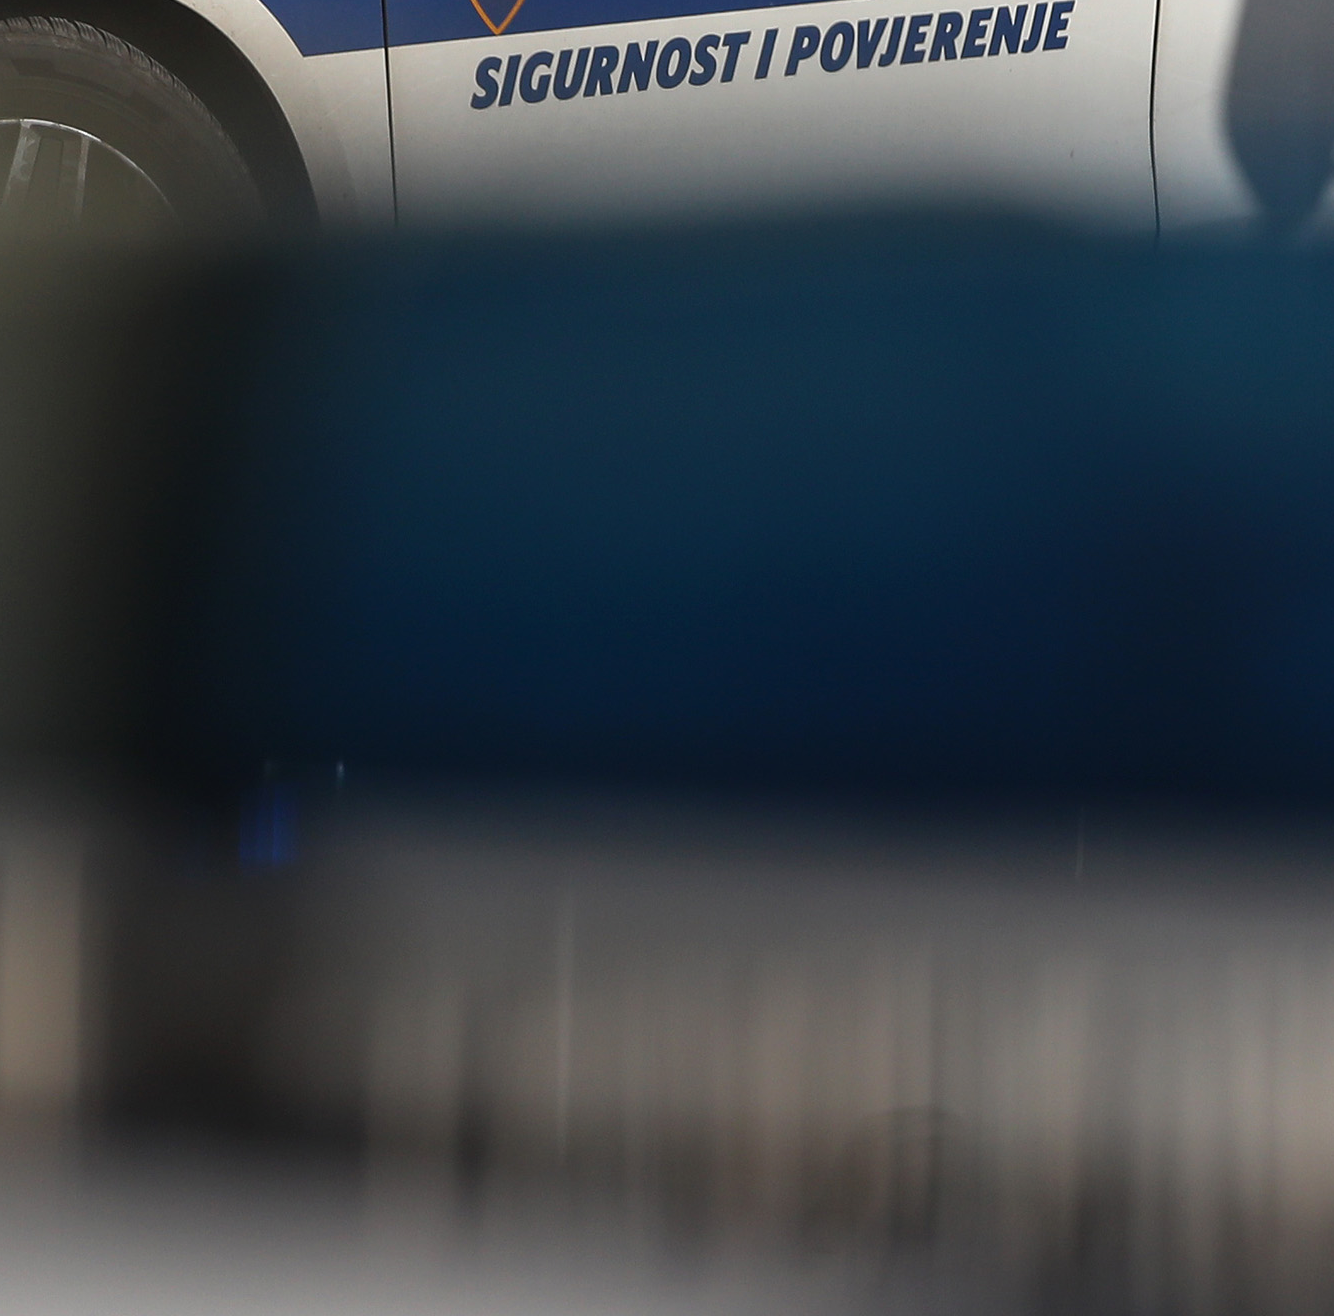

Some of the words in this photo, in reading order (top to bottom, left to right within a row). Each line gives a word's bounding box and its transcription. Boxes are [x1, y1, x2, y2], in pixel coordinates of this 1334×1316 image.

[469, 31, 751, 110] SIGURNOST
[754, 27, 781, 81] I
[784, 0, 1076, 78] POVJERENJE
